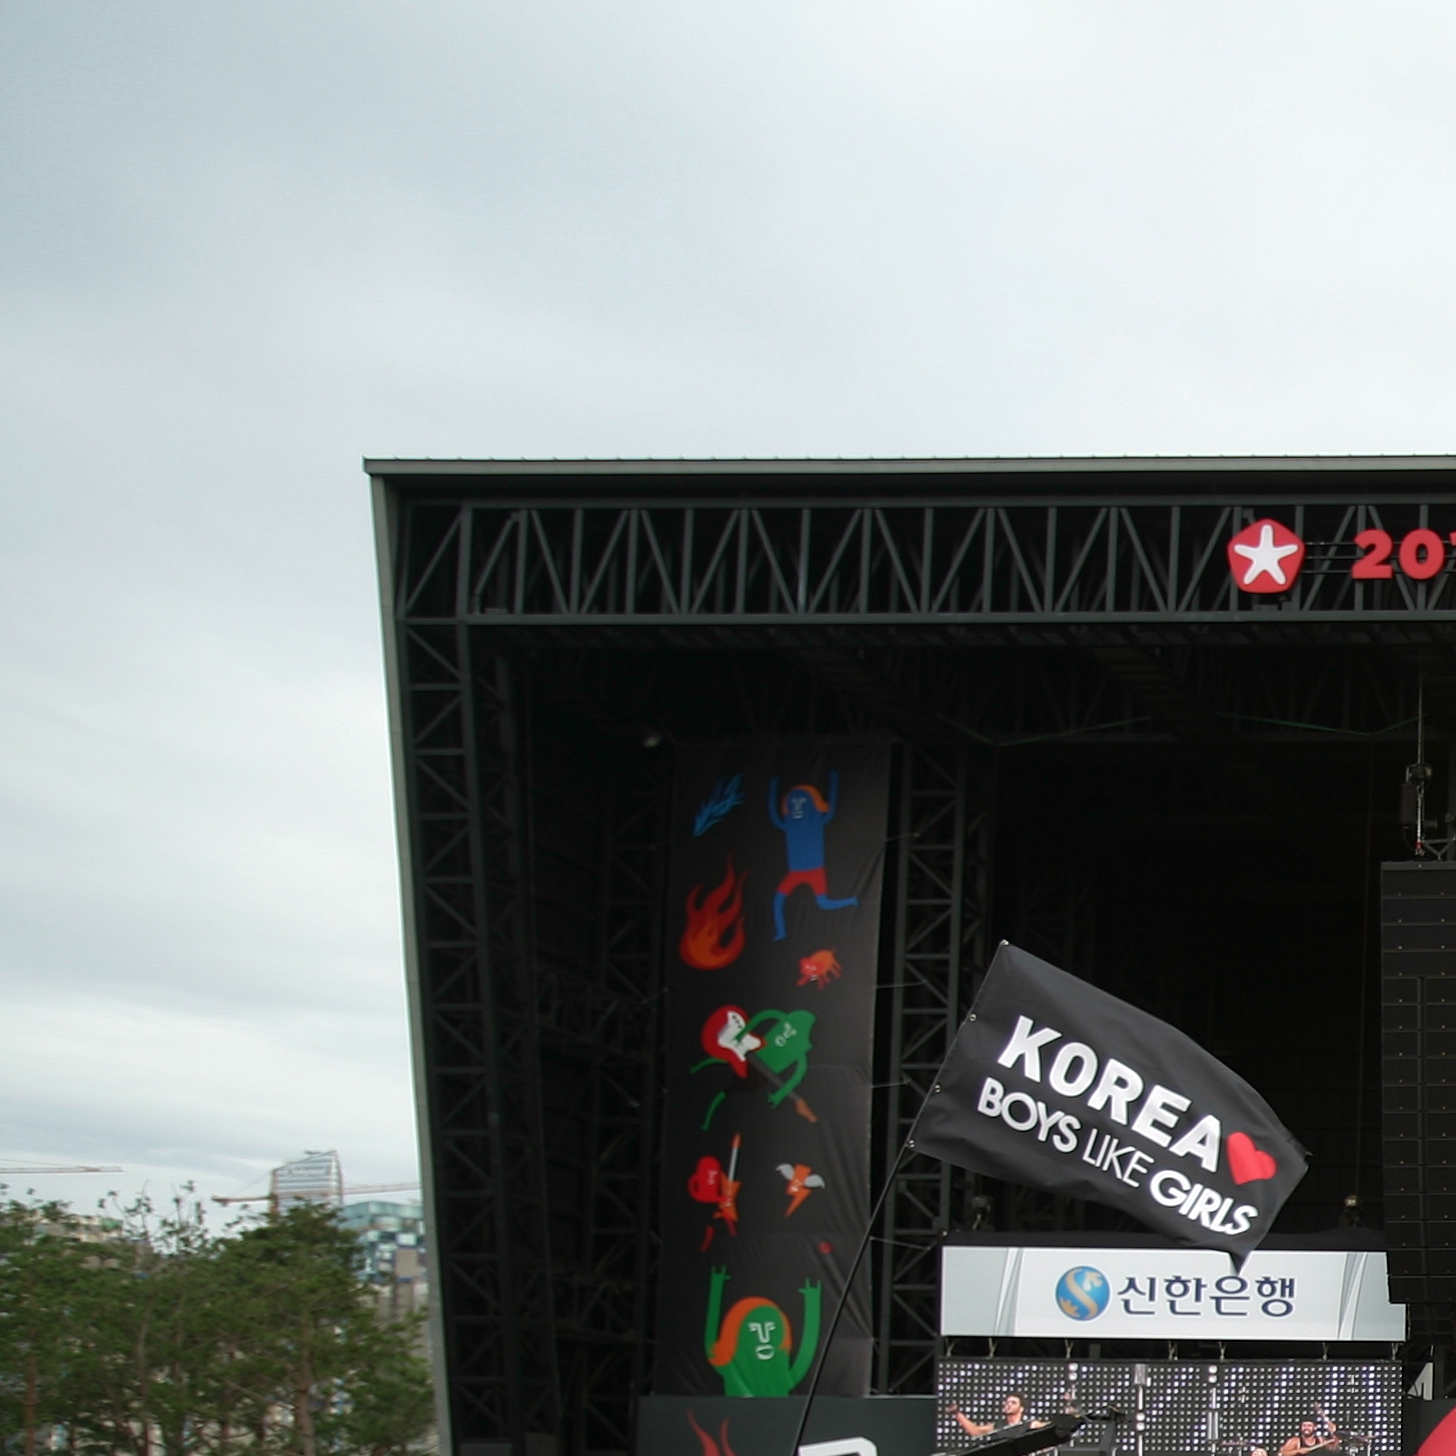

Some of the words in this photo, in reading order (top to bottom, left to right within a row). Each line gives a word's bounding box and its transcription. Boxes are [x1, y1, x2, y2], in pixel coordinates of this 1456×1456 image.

[977, 1077, 1081, 1153] BOYS
[1082, 1128, 1154, 1188] LIKE
[1149, 1169, 1258, 1235] GIRLS
[997, 1014, 1223, 1173] KOREA
[1118, 1274, 1297, 1318] 신한은행
